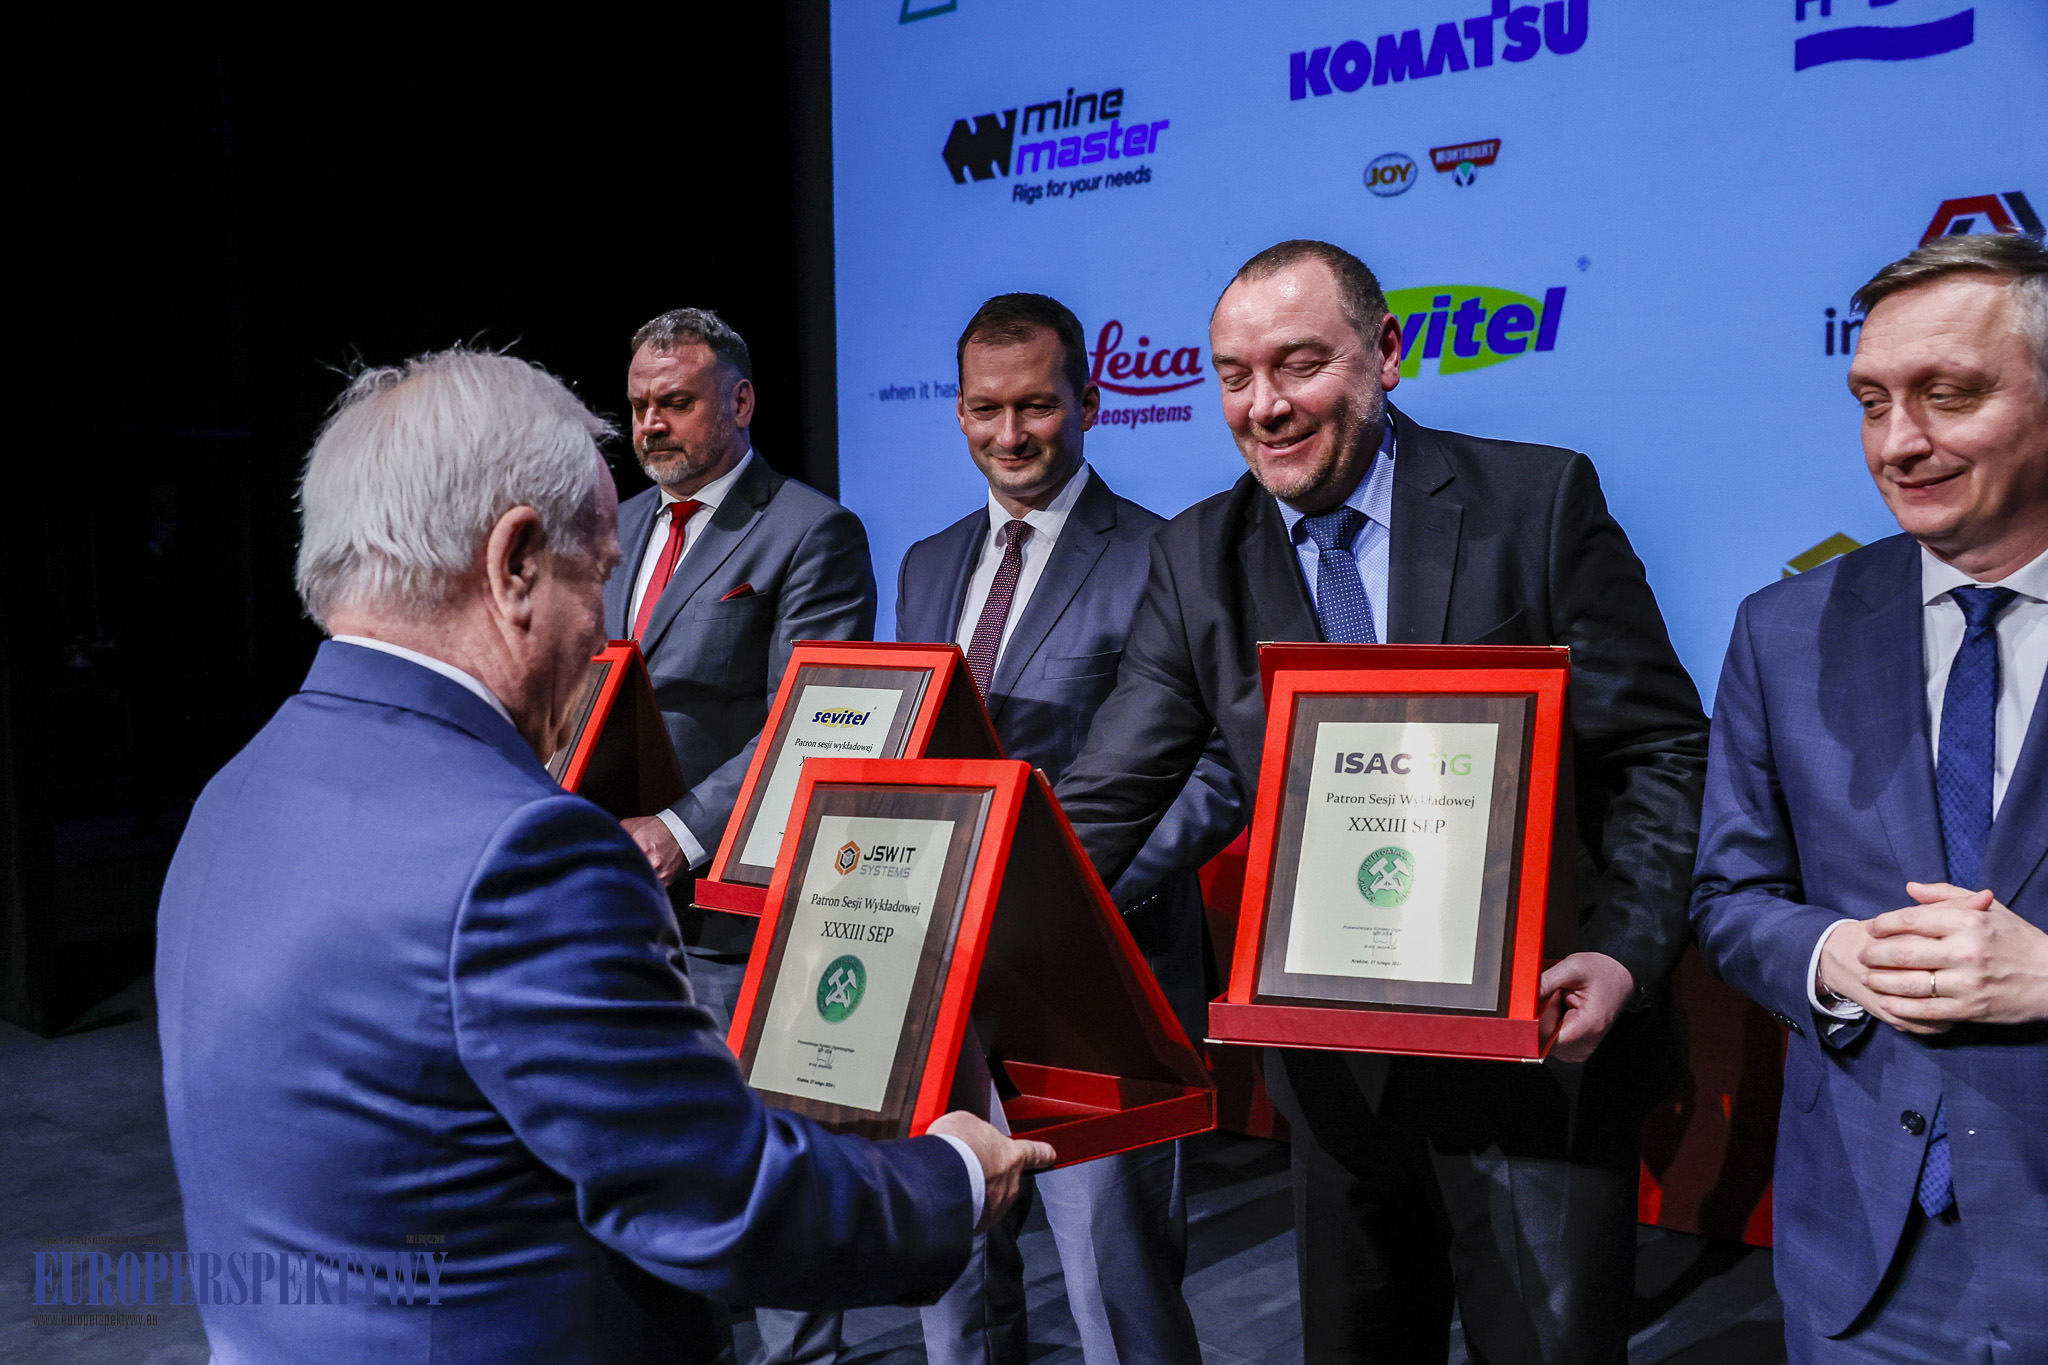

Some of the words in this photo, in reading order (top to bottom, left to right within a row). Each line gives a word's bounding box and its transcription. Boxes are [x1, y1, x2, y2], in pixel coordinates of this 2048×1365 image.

[1290, 0, 1588, 100] KOMATSU
[1022, 87, 1124, 135] mine
[1016, 119, 1170, 175] master
[1012, 184, 1043, 205] Rigs
[1046, 179, 1067, 198] for
[1069, 174, 1102, 198] your
[1105, 165, 1153, 189] needs
[1367, 163, 1412, 187] JOY
[1089, 320, 1204, 395] Leica
[879, 383, 916, 402] when
[919, 380, 930, 399] it
[812, 710, 871, 726] sevitel
[795, 738, 817, 748] Patron
[817, 740, 833, 750] sesji
[833, 741, 874, 753] wykładowej
[1334, 752, 1412, 775] ISAC
[1326, 792, 1365, 804] Patron
[1368, 794, 1396, 807] Sesji
[1347, 817, 1407, 833] XXXIII
[864, 845, 899, 863] JSW
[860, 865, 911, 878] SYSTEMS
[811, 893, 840, 907] Patron
[841, 896, 863, 911] Sesji
[864, 898, 921, 916] Wykładowej
[820, 921, 866, 941] XXXIII
[866, 926, 894, 943] SEP
